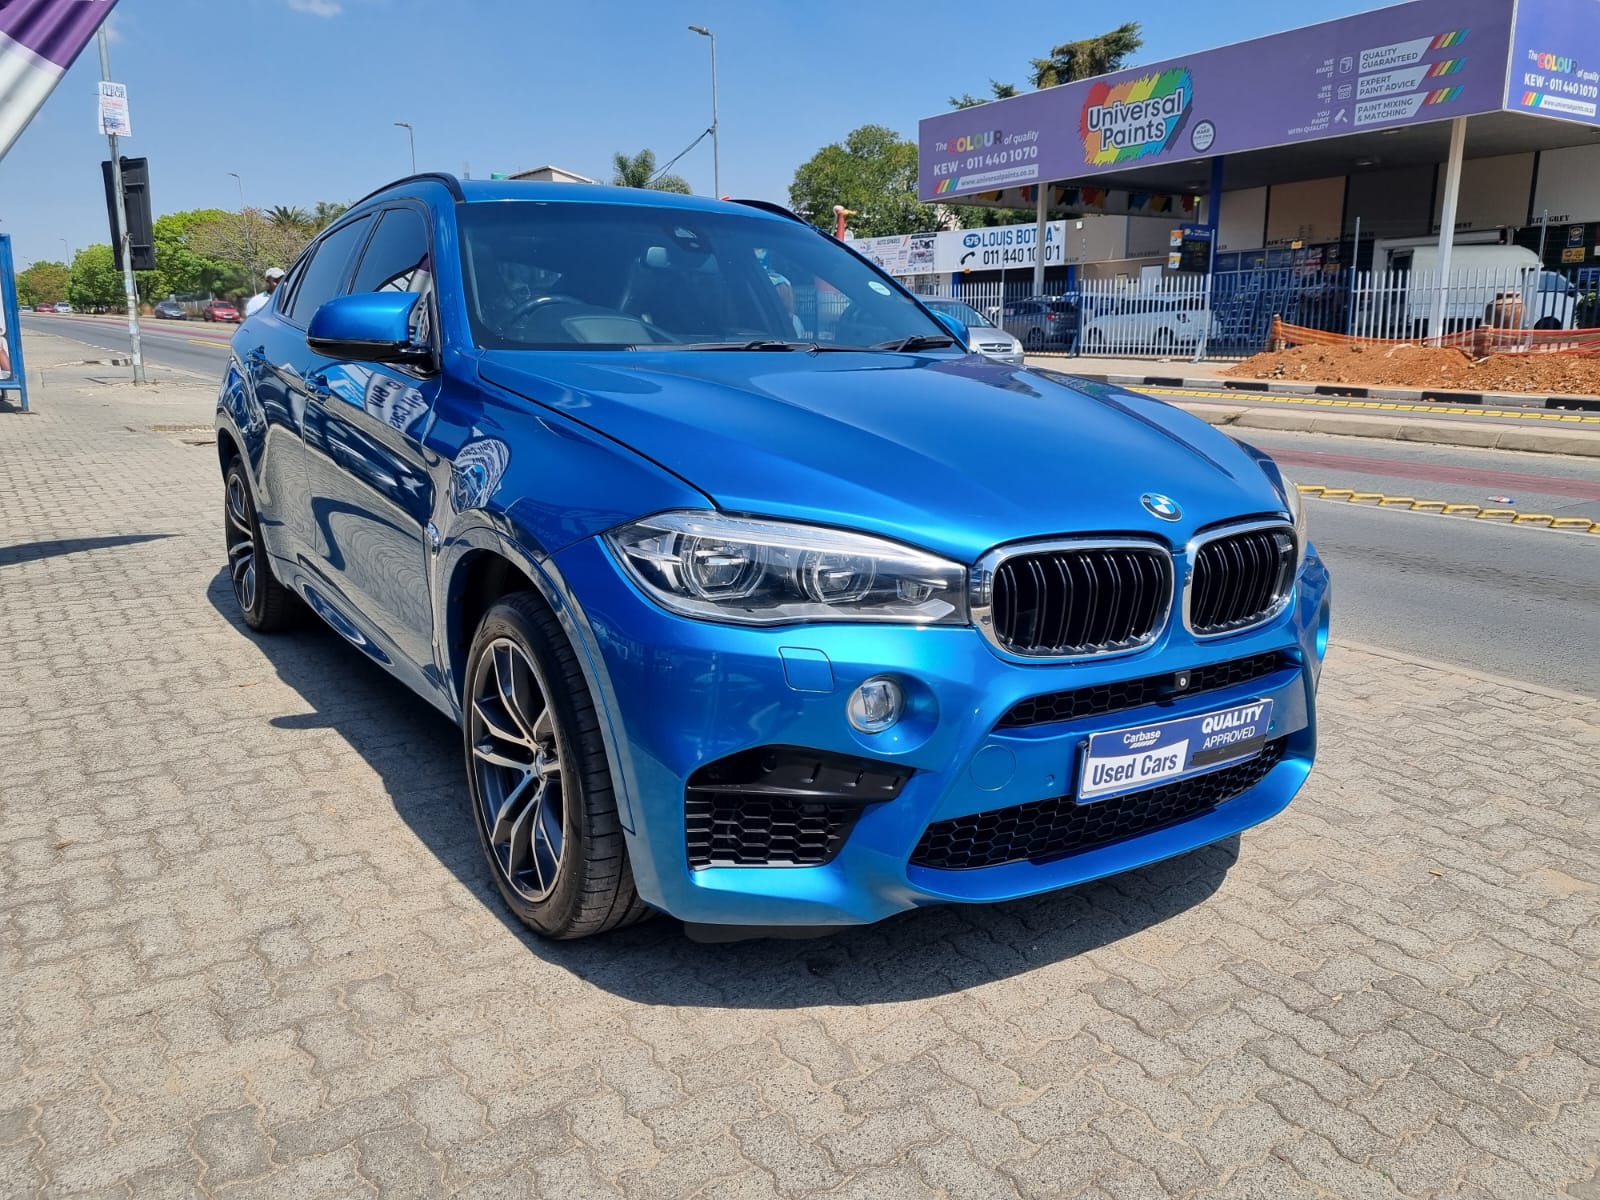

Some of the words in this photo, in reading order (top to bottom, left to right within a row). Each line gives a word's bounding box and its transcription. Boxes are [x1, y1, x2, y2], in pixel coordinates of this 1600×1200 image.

[1362, 48, 1397, 61] QUALITY
[1362, 52, 1418, 69] GUARANTEED
[1528, 49, 1538, 61] The
[1537, 52, 1578, 74] COLOUR
[1359, 85, 1384, 96] PAINT
[1385, 79, 1417, 91] ADVICE
[1360, 74, 1392, 87] EXPERT
[1524, 72, 1545, 88] KEW
[1549, 78, 1562, 92] 011
[1563, 81, 1579, 95] 440
[1580, 84, 1598, 98] 1070
[1089, 89, 1183, 129] Universal
[1357, 103, 1383, 114] PAINT
[1383, 98, 1413, 109] MIXING
[1364, 107, 1407, 120] MATCHING
[935, 142, 947, 152] The
[947, 130, 1003, 154] COLOUR
[1004, 133, 1012, 145] of
[1012, 130, 1039, 146] quality
[1102, 119, 1165, 149] Paints
[933, 160, 959, 176] KEW
[966, 156, 983, 169] 011
[986, 152, 1007, 166] 440
[1010, 146, 1038, 162] 1070
[982, 230, 1013, 248] LOUIS
[1016, 226, 1053, 245] BOTA
[983, 249, 999, 265] 011
[1003, 248, 1024, 263] 440
[1202, 704, 1265, 735] QUALITY
[1123, 730, 1161, 744] Carbase
[1203, 726, 1256, 750] APPROVED
[1092, 758, 1136, 786] Used
[1140, 753, 1178, 775] Cars
